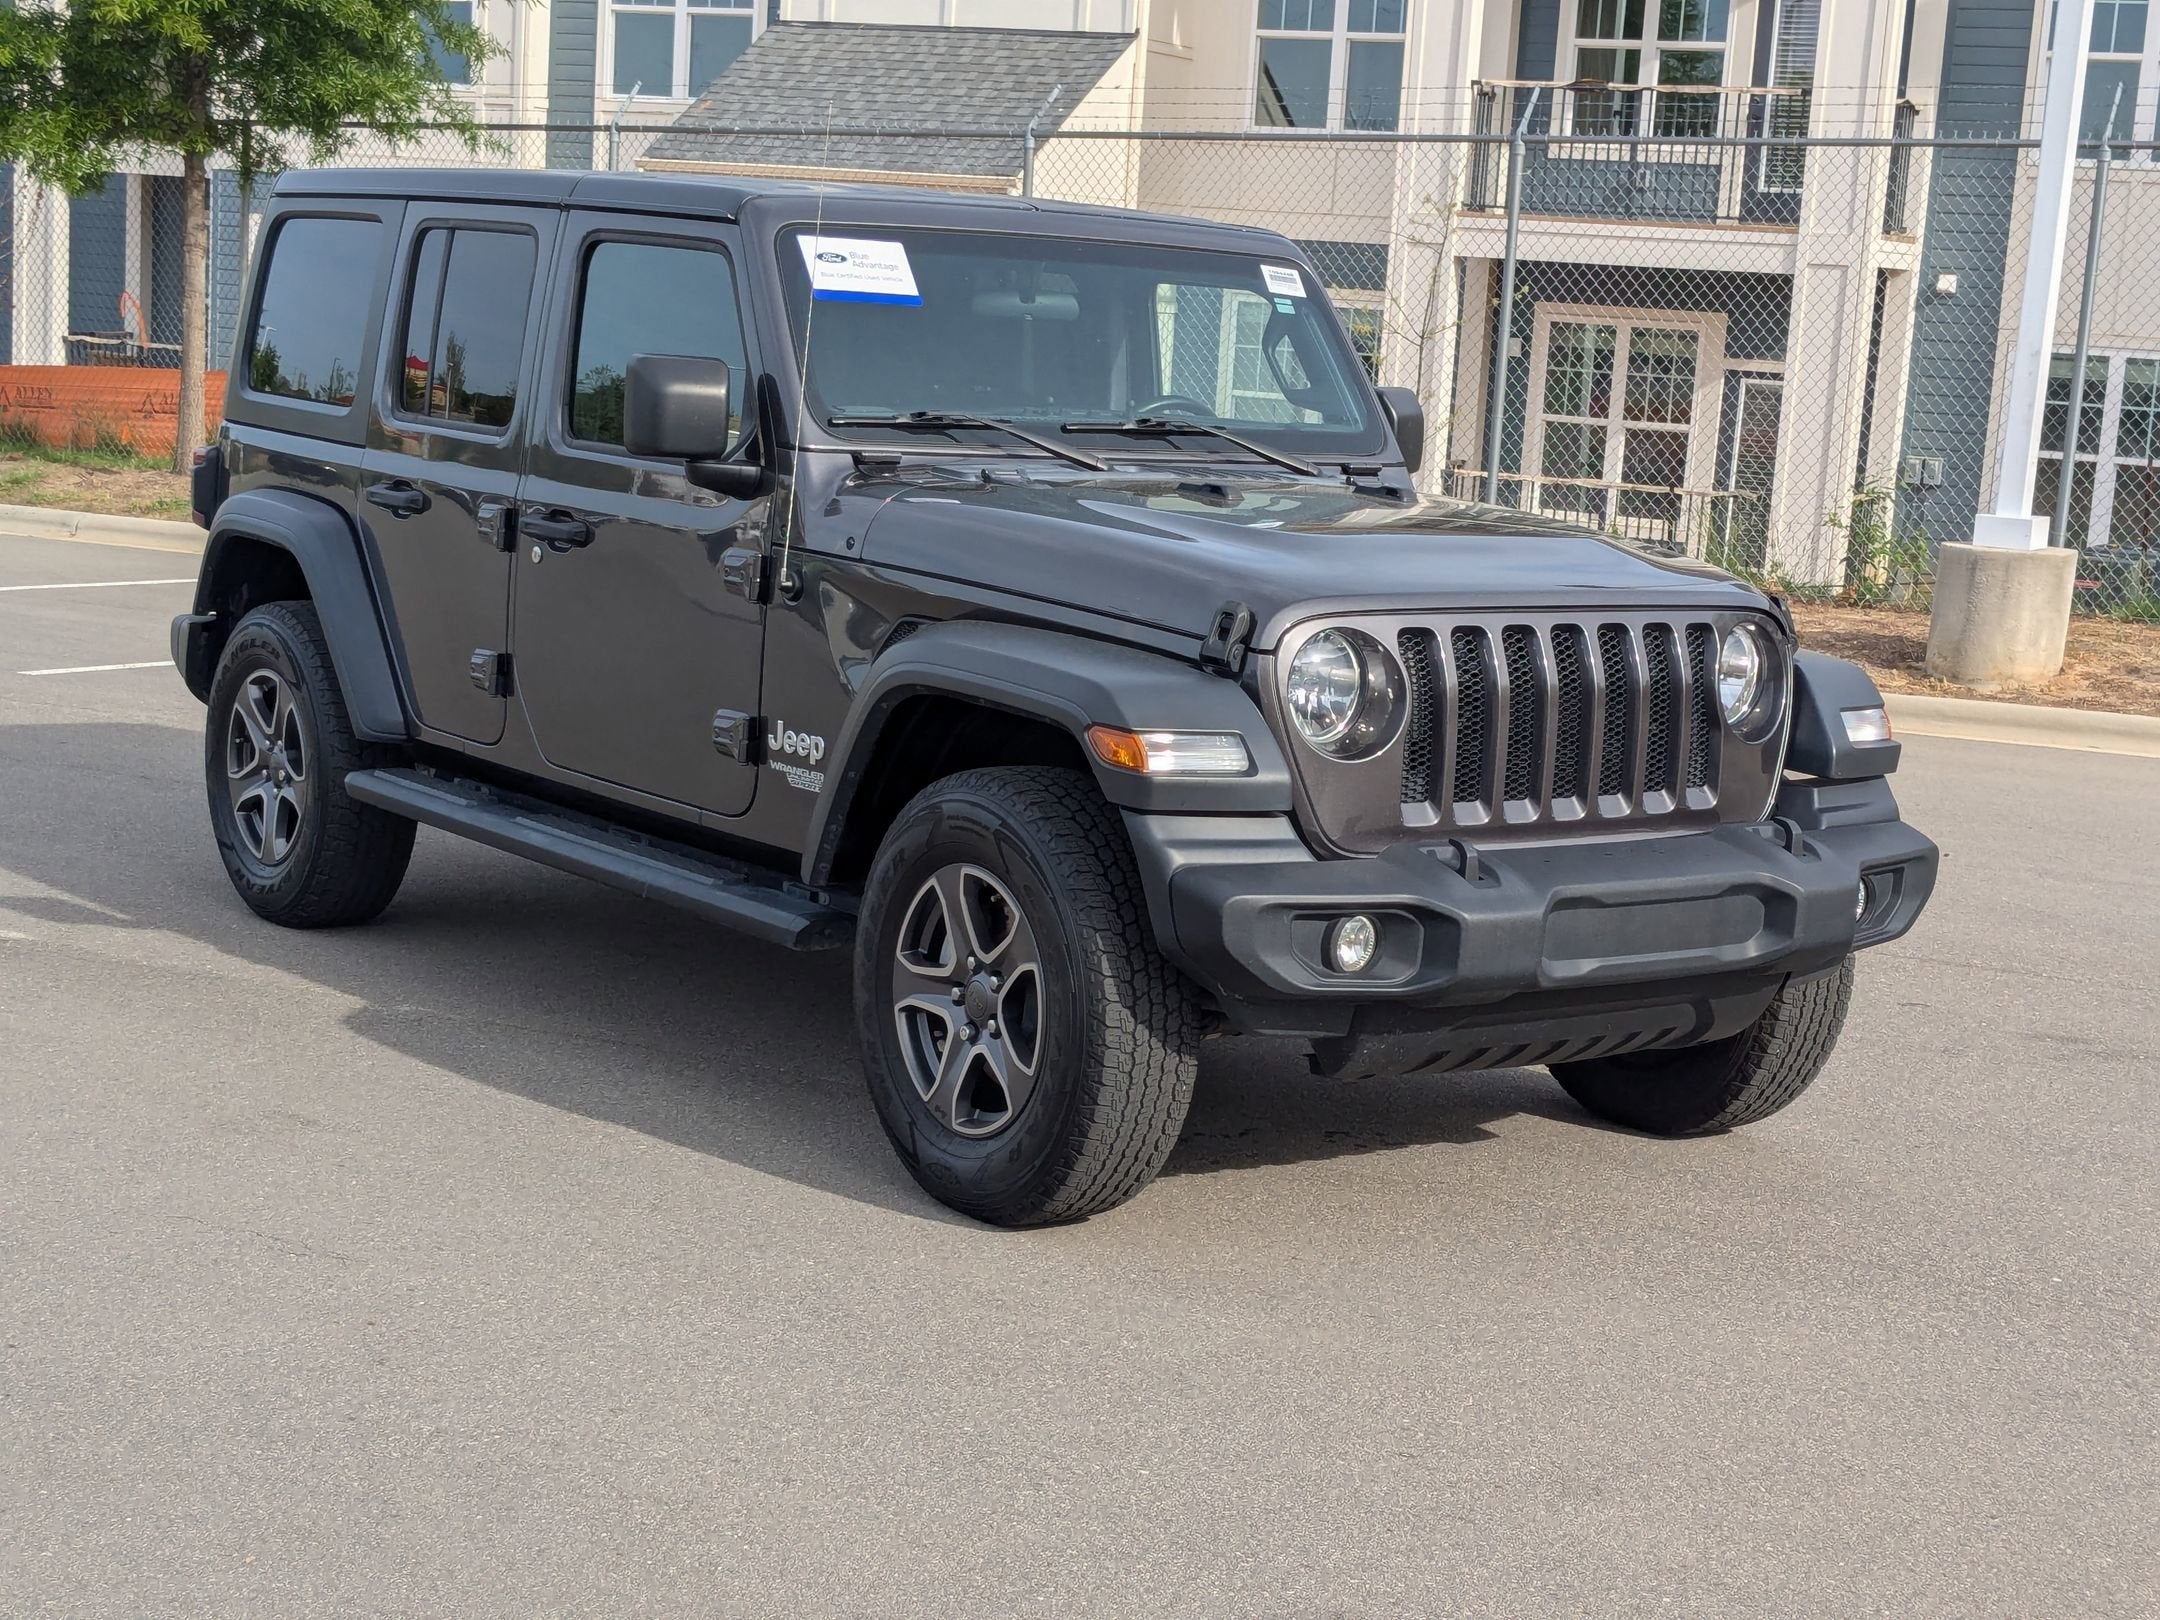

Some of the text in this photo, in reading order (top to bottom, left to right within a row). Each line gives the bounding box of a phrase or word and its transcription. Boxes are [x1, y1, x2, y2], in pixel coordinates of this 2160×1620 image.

[849, 251, 870, 260] Blue
[852, 261, 900, 272] Advantage
[768, 720, 825, 766] Jeep
[769, 760, 825, 782] WRANGLER
